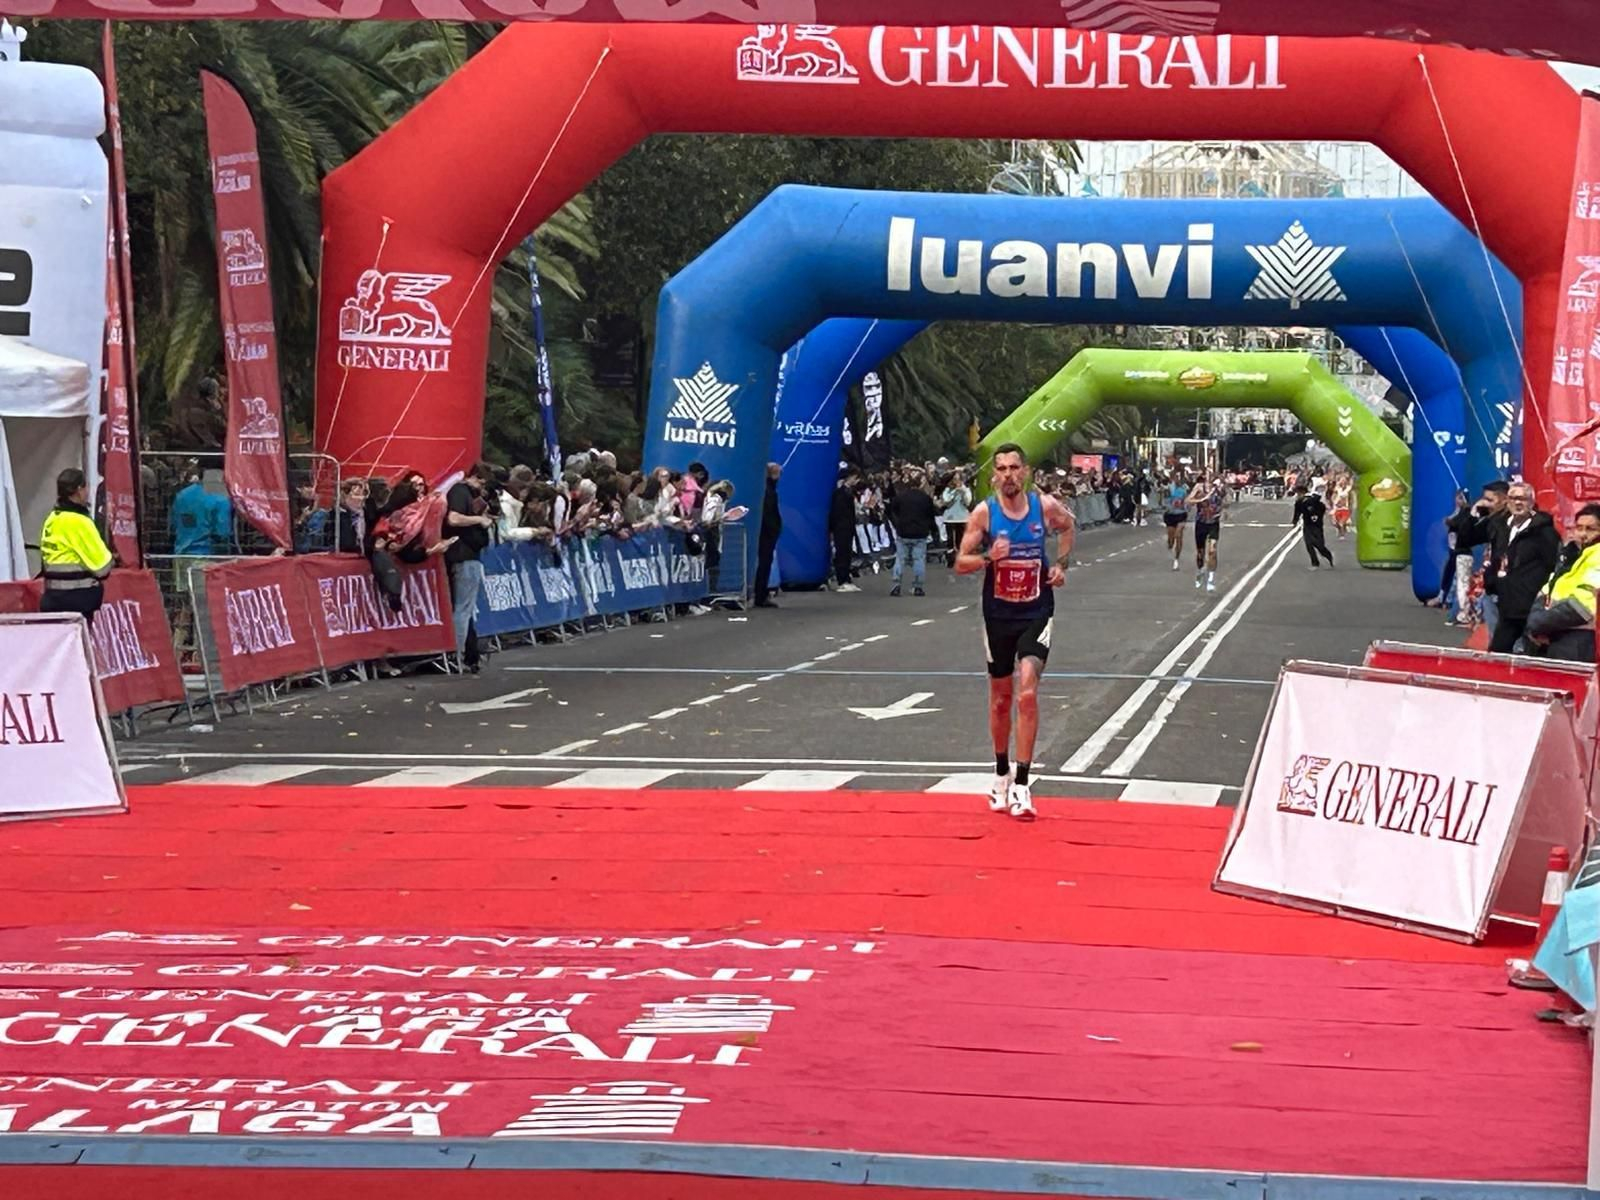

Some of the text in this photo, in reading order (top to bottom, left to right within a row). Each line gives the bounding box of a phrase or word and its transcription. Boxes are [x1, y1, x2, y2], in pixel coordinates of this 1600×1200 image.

[867, 26, 1287, 90] GENERALI
[887, 216, 1214, 299] luanvi
[337, 344, 451, 372] GENERALI
[664, 421, 736, 448] luanvi
[1322, 760, 1498, 846] GENERALI
[157, 963, 828, 982] GENERALI
[0, 1011, 751, 1067] GENERALI
[127, 1098, 449, 1112] MARATON
